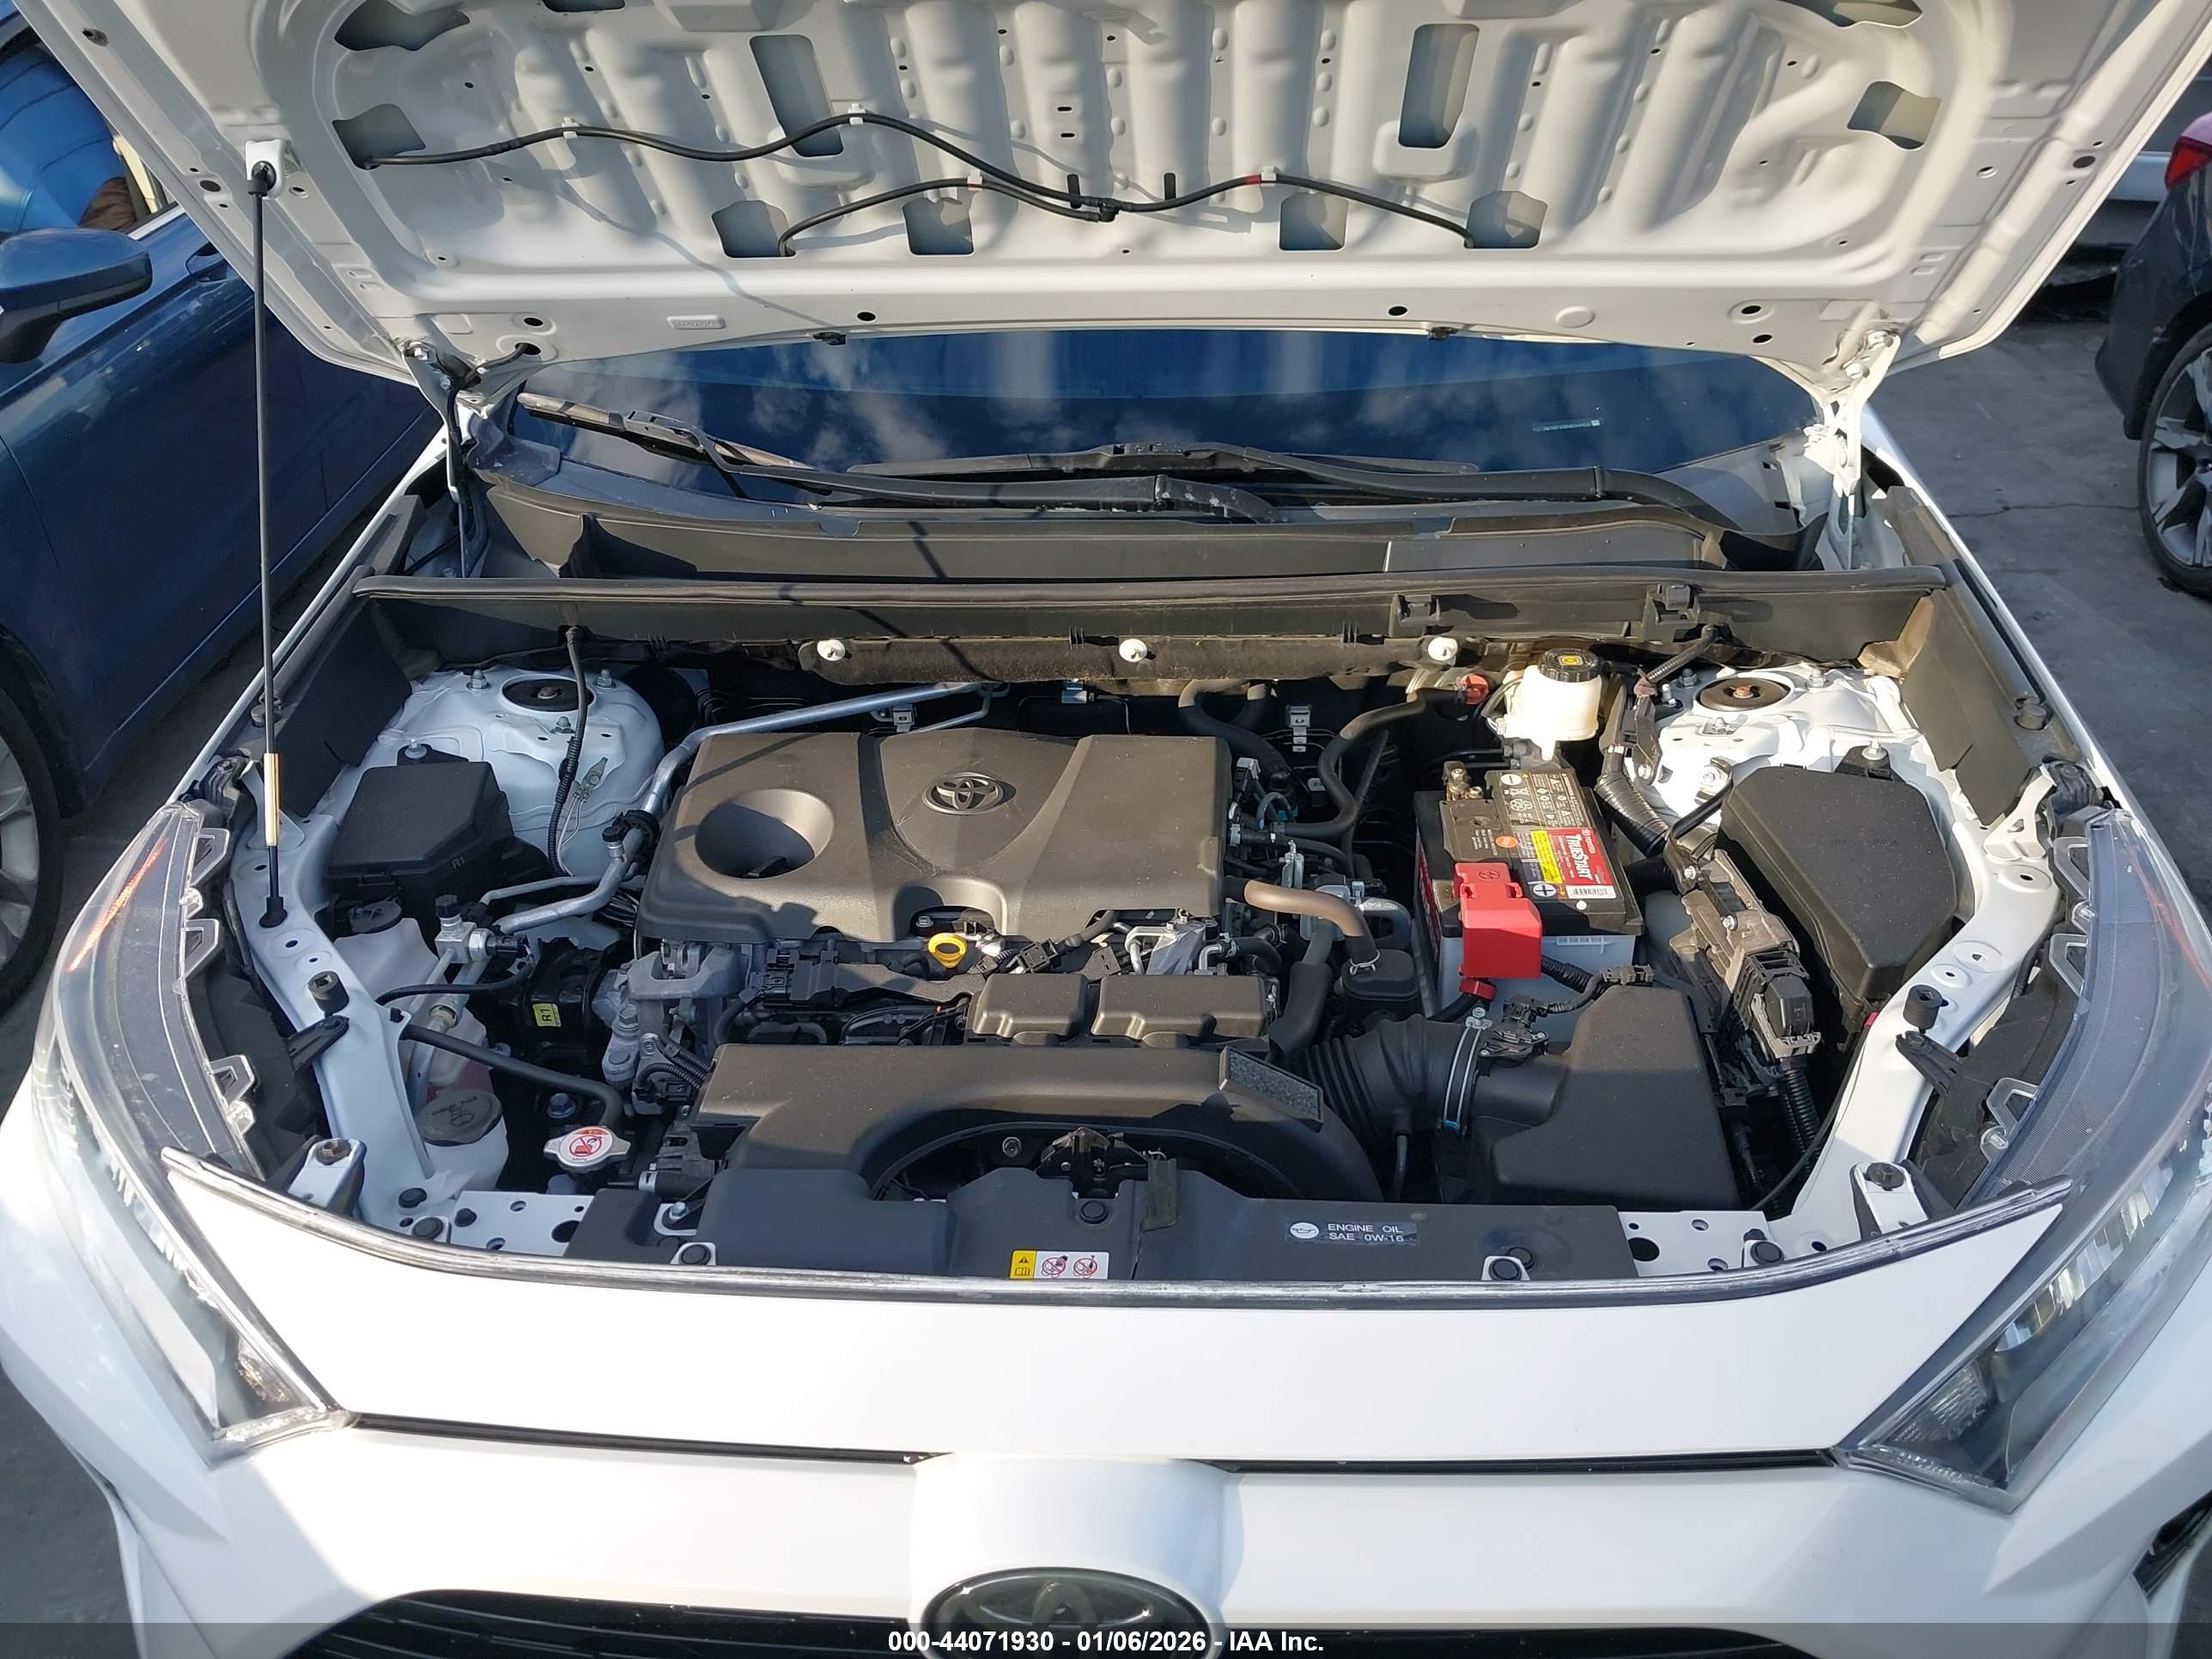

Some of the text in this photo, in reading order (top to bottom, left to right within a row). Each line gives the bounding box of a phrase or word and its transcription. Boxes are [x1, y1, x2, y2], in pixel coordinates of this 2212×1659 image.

[1584, 835, 1595, 855] TOYOTA
[539, 1009, 552, 1022] R1
[1327, 1223, 1404, 1234] ENGINE OIL
[1328, 1232, 1405, 1243] SAE 0W-16
